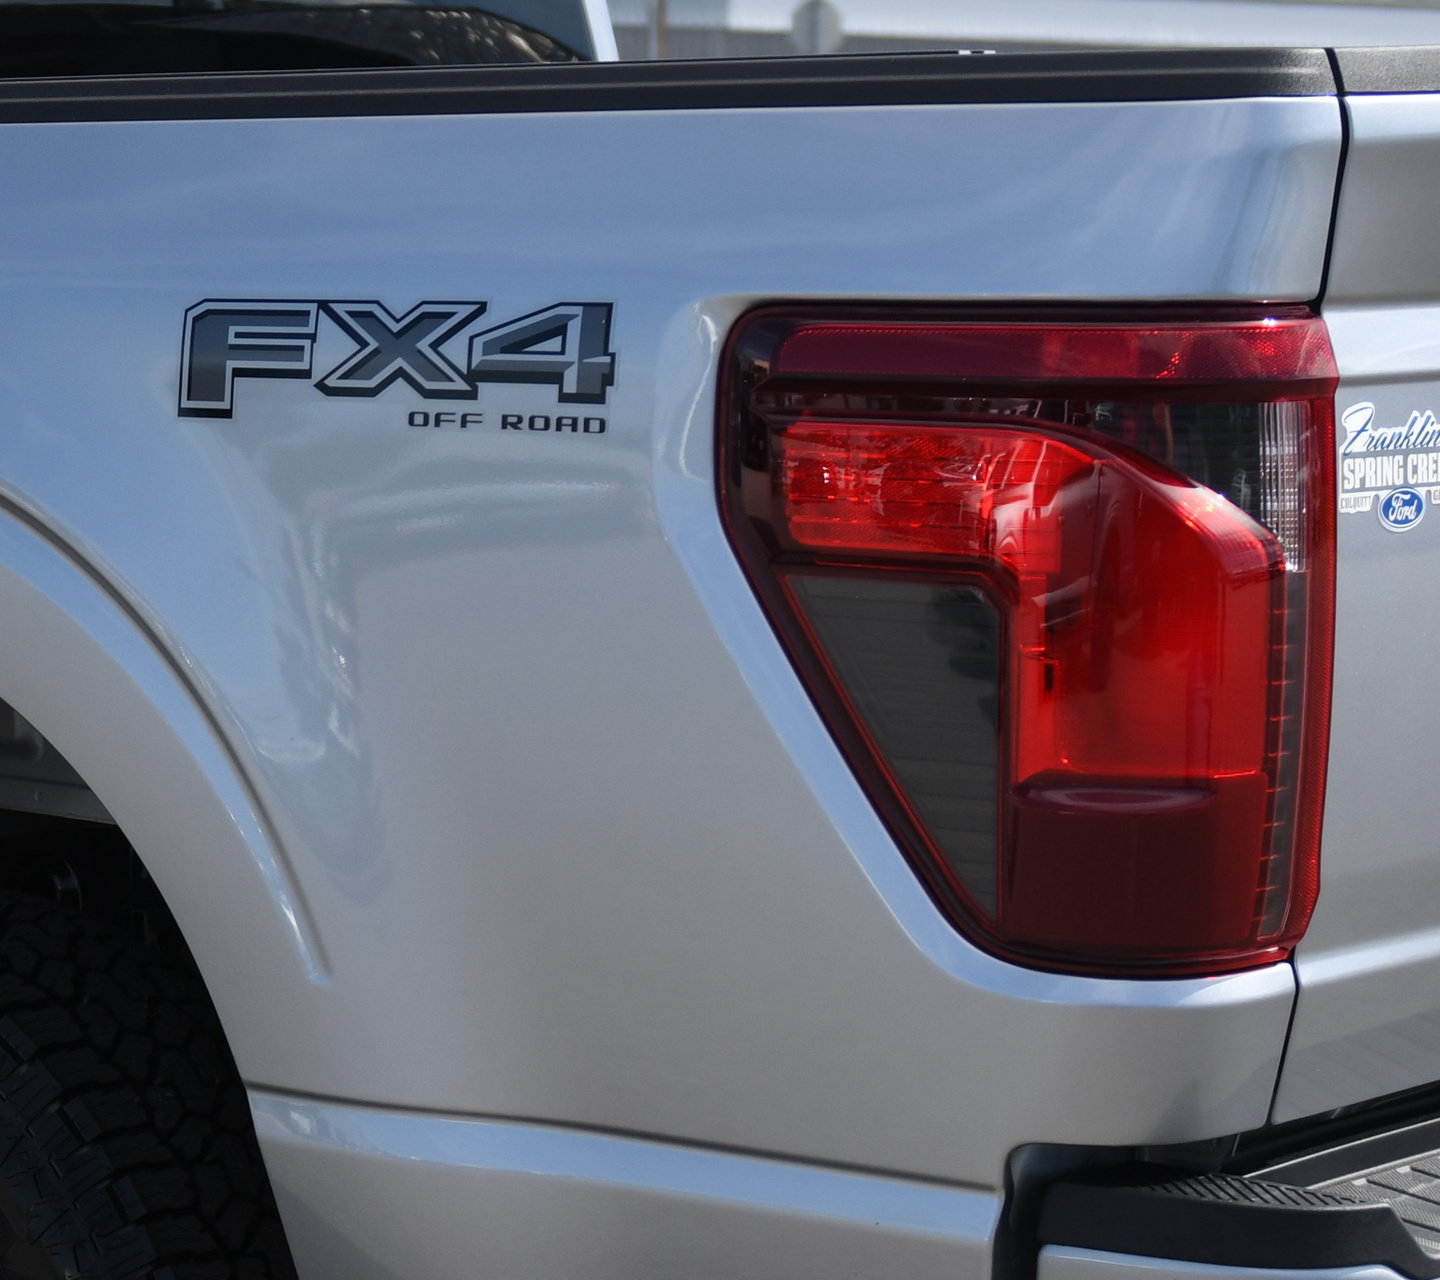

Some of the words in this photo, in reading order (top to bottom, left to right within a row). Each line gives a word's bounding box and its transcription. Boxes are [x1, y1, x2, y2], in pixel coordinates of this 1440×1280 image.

[177, 298, 616, 418] FX4
[407, 411, 484, 429] OFF
[500, 414, 607, 434] ROAD
[1343, 455, 1404, 490] SPRING
[1388, 493, 1418, 521] Ford
